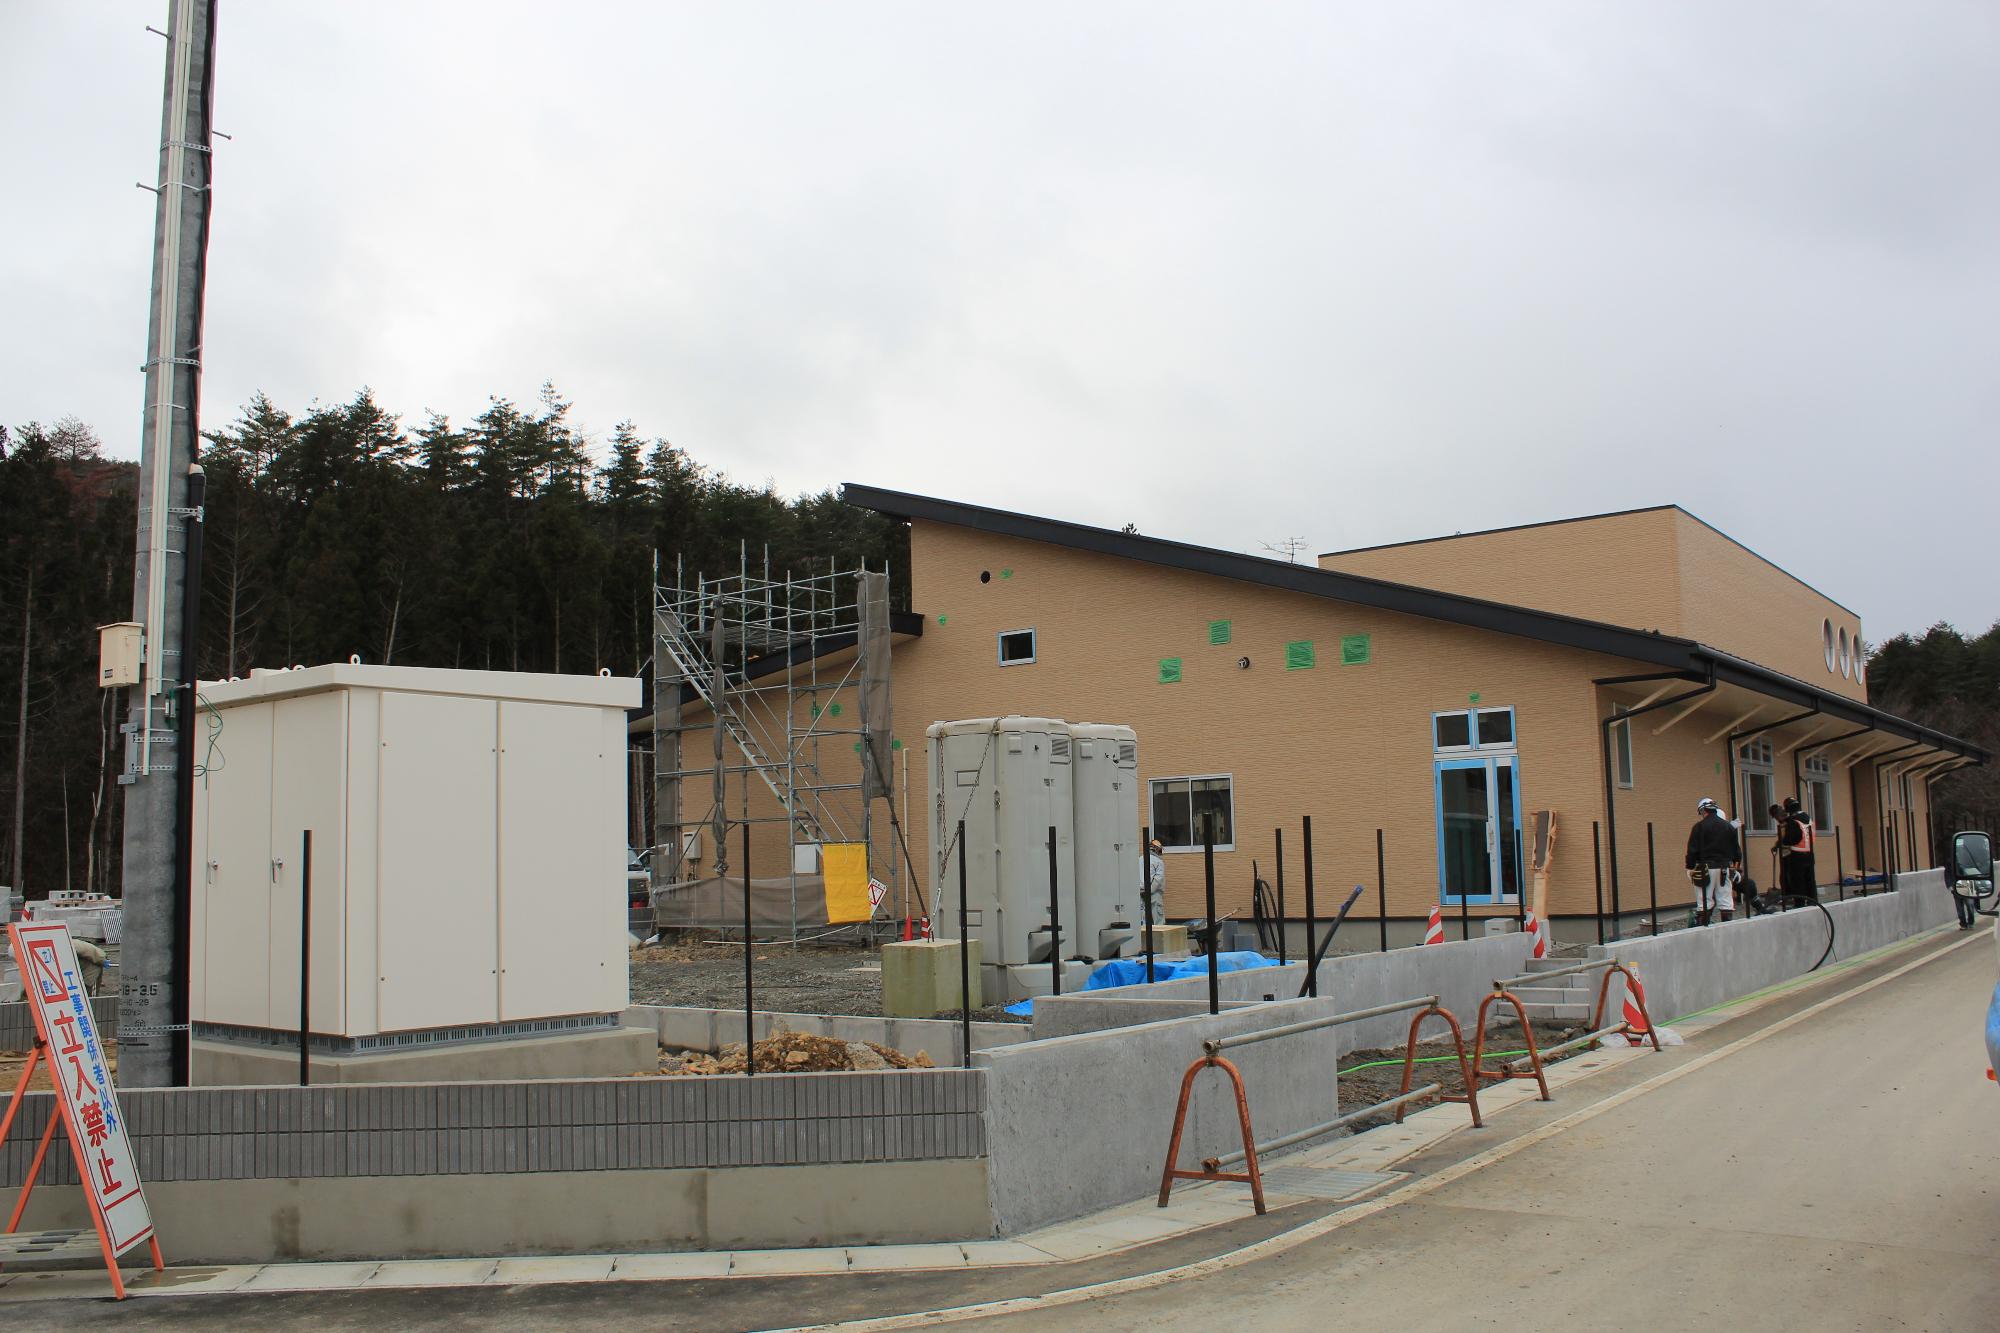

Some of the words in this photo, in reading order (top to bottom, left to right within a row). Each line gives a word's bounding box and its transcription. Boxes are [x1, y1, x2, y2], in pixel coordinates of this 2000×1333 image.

[53, 1009, 122, 1196] 立入禁止
[64, 971, 118, 1135] 工事関係者以外
